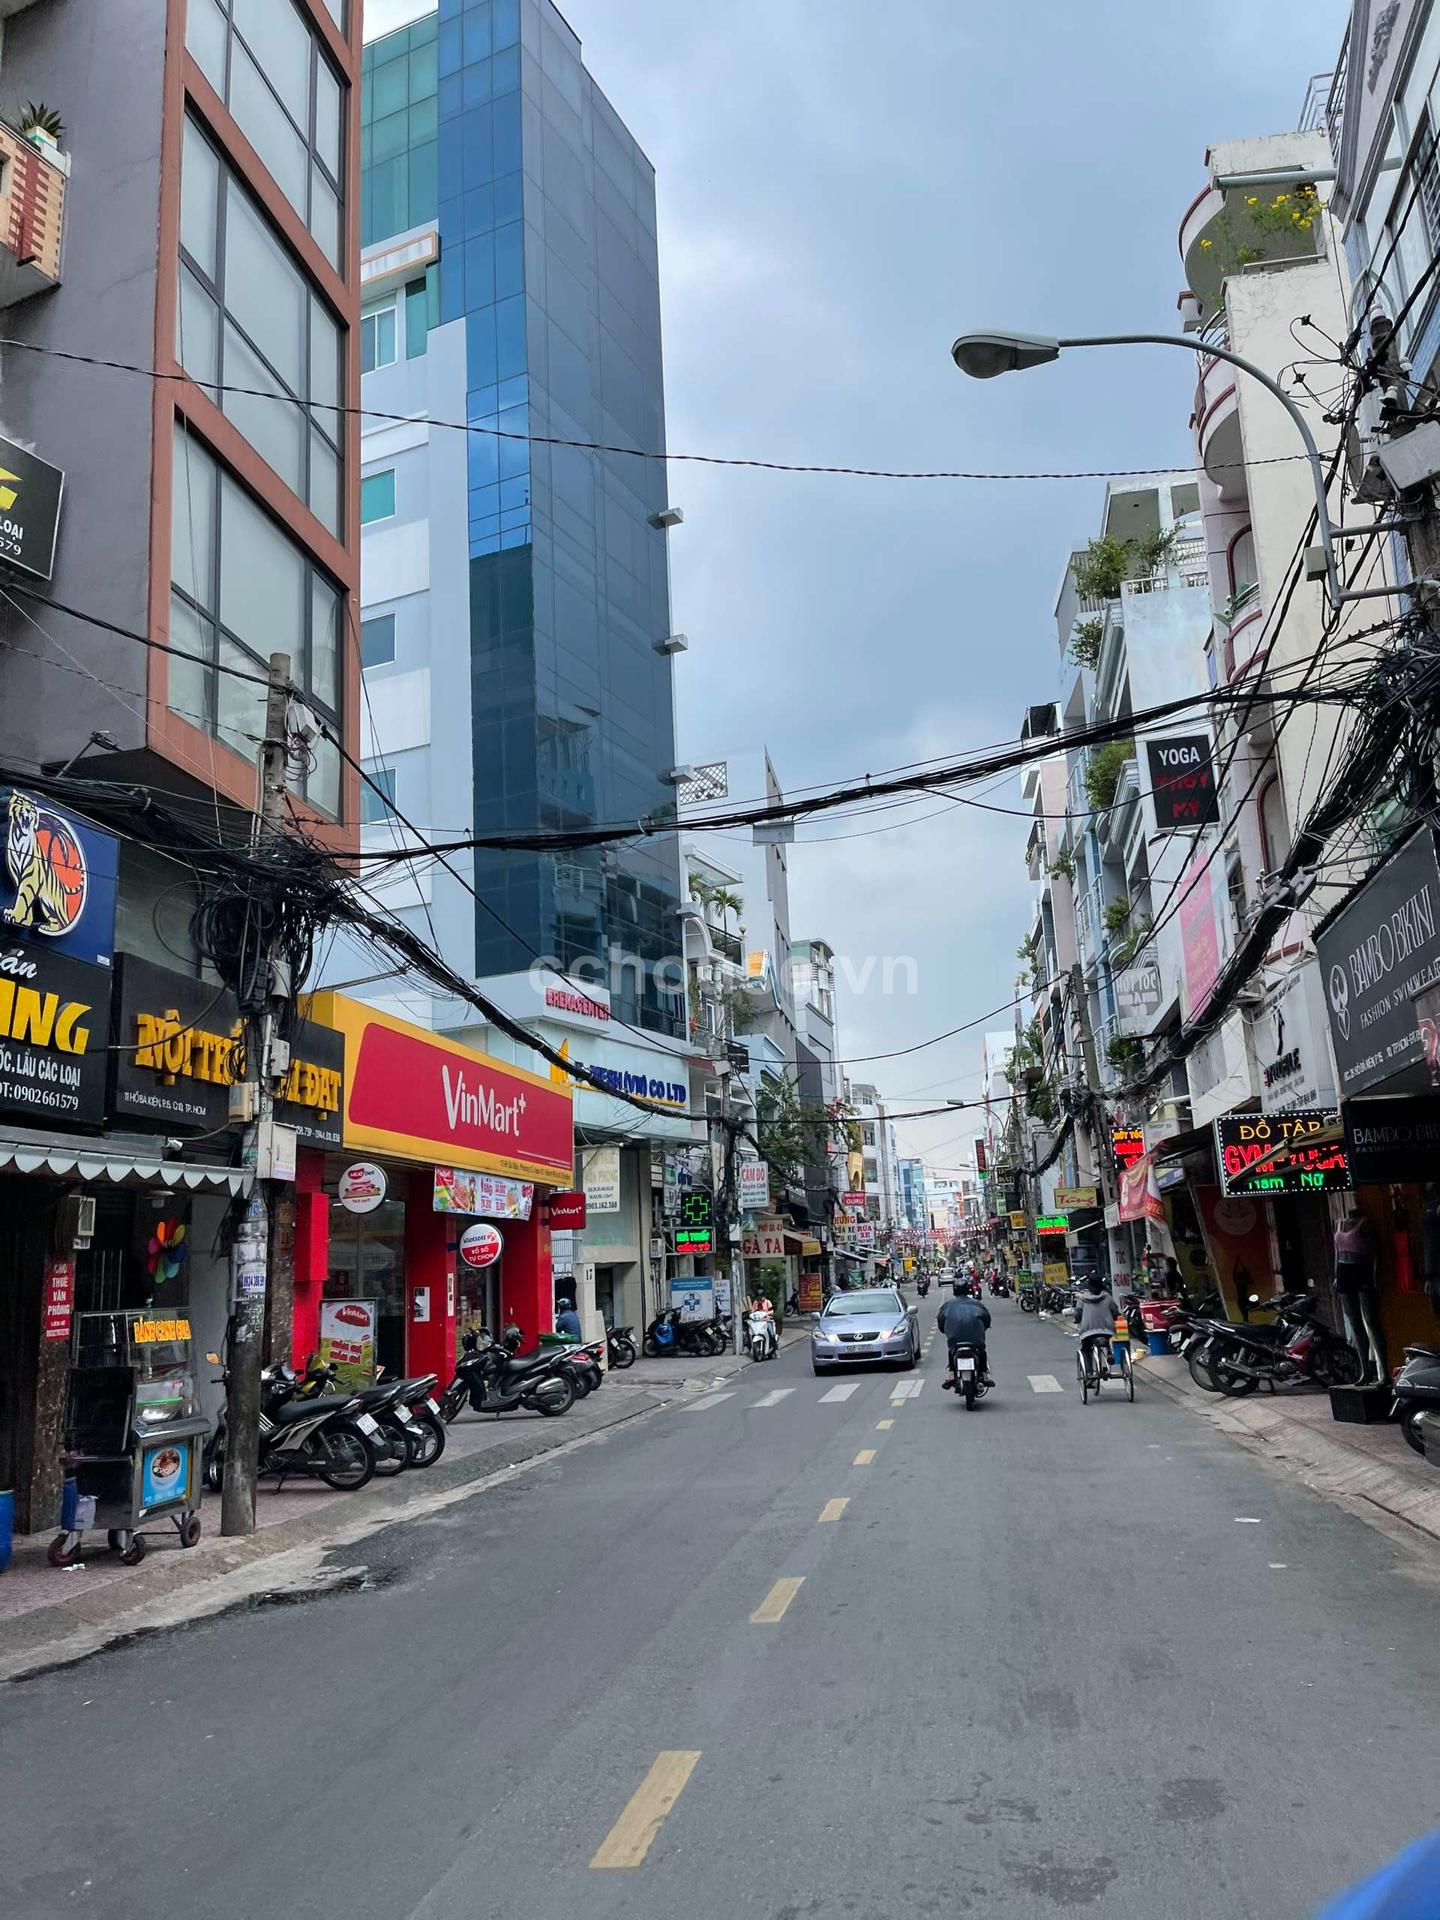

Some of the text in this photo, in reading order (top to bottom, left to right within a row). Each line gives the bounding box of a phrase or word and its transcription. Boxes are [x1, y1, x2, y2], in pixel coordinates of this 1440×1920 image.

[1158, 745, 1201, 767] YOGA
[1391, 883, 1437, 963] BIKINI
[0, 950, 38, 979] án
[1360, 994, 1392, 1030] FASHION
[135, 1008, 193, 1086] NỘI
[38, 1057, 58, 1082] CÁC
[59, 1064, 81, 1091] LOẠI
[649, 1078, 665, 1099] CO
[667, 1082, 686, 1104] LTD
[1239, 1118, 1271, 1140] ĐỒ
[742, 1233, 782, 1255] GÀ TA
